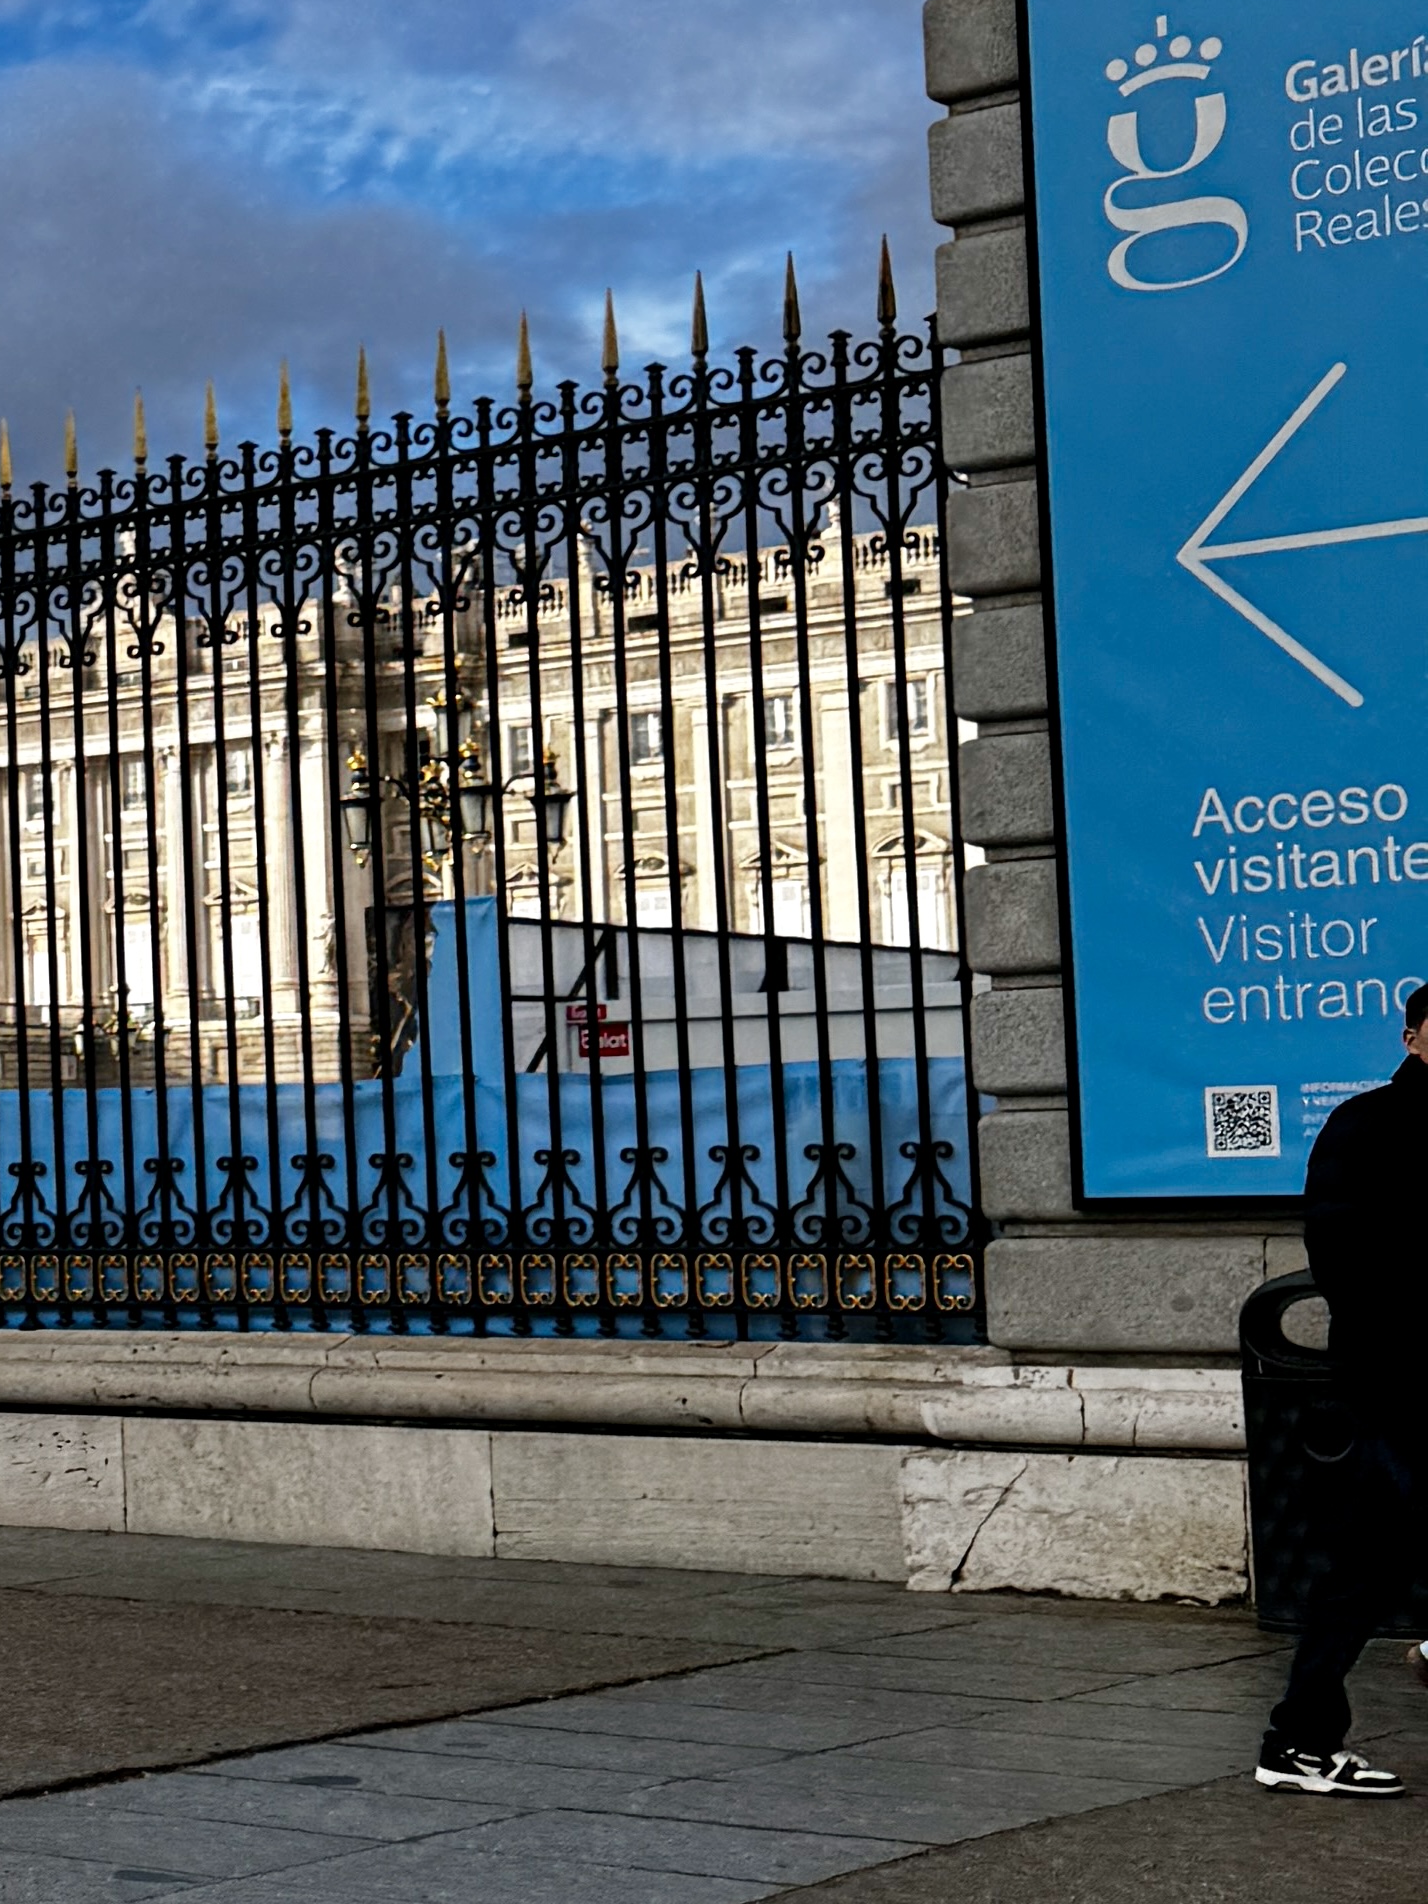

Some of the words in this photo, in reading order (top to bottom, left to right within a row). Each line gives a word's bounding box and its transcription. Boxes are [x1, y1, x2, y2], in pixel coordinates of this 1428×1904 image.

[1285, 35, 1428, 103] Galerí
[1289, 108, 1343, 152] de
[1357, 96, 1418, 139] las
[1295, 193, 1428, 252] Reale
[1192, 783, 1408, 837] Acceso
[1194, 835, 1428, 895] visitante
[1198, 912, 1378, 964] Visitor
